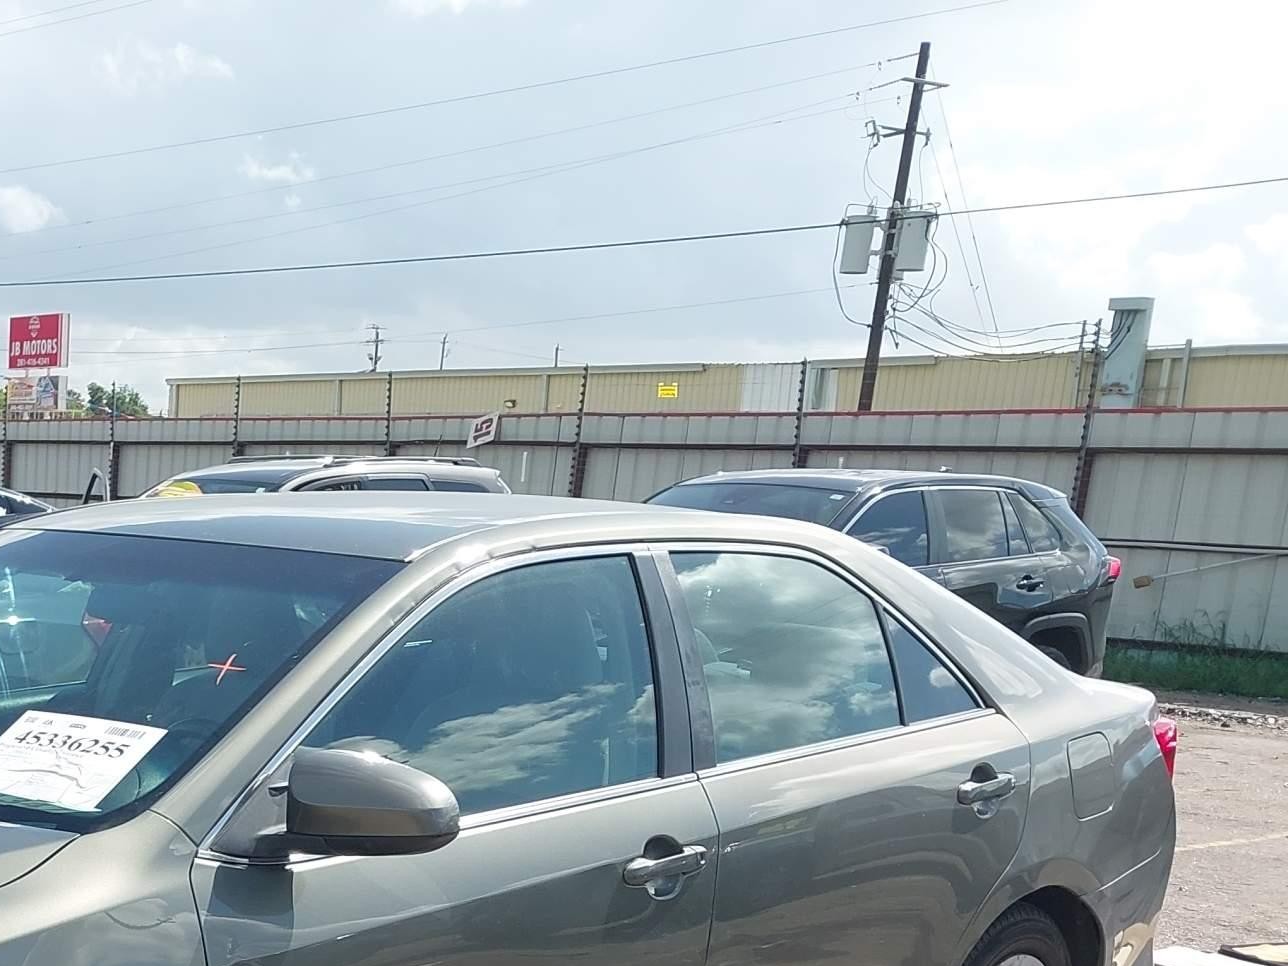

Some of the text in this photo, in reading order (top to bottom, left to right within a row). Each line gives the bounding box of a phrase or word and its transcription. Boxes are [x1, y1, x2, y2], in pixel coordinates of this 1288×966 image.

[10, 338, 58, 357] JB MOTORS
[472, 417, 494, 443] 15
[14, 730, 132, 759] 45336255
